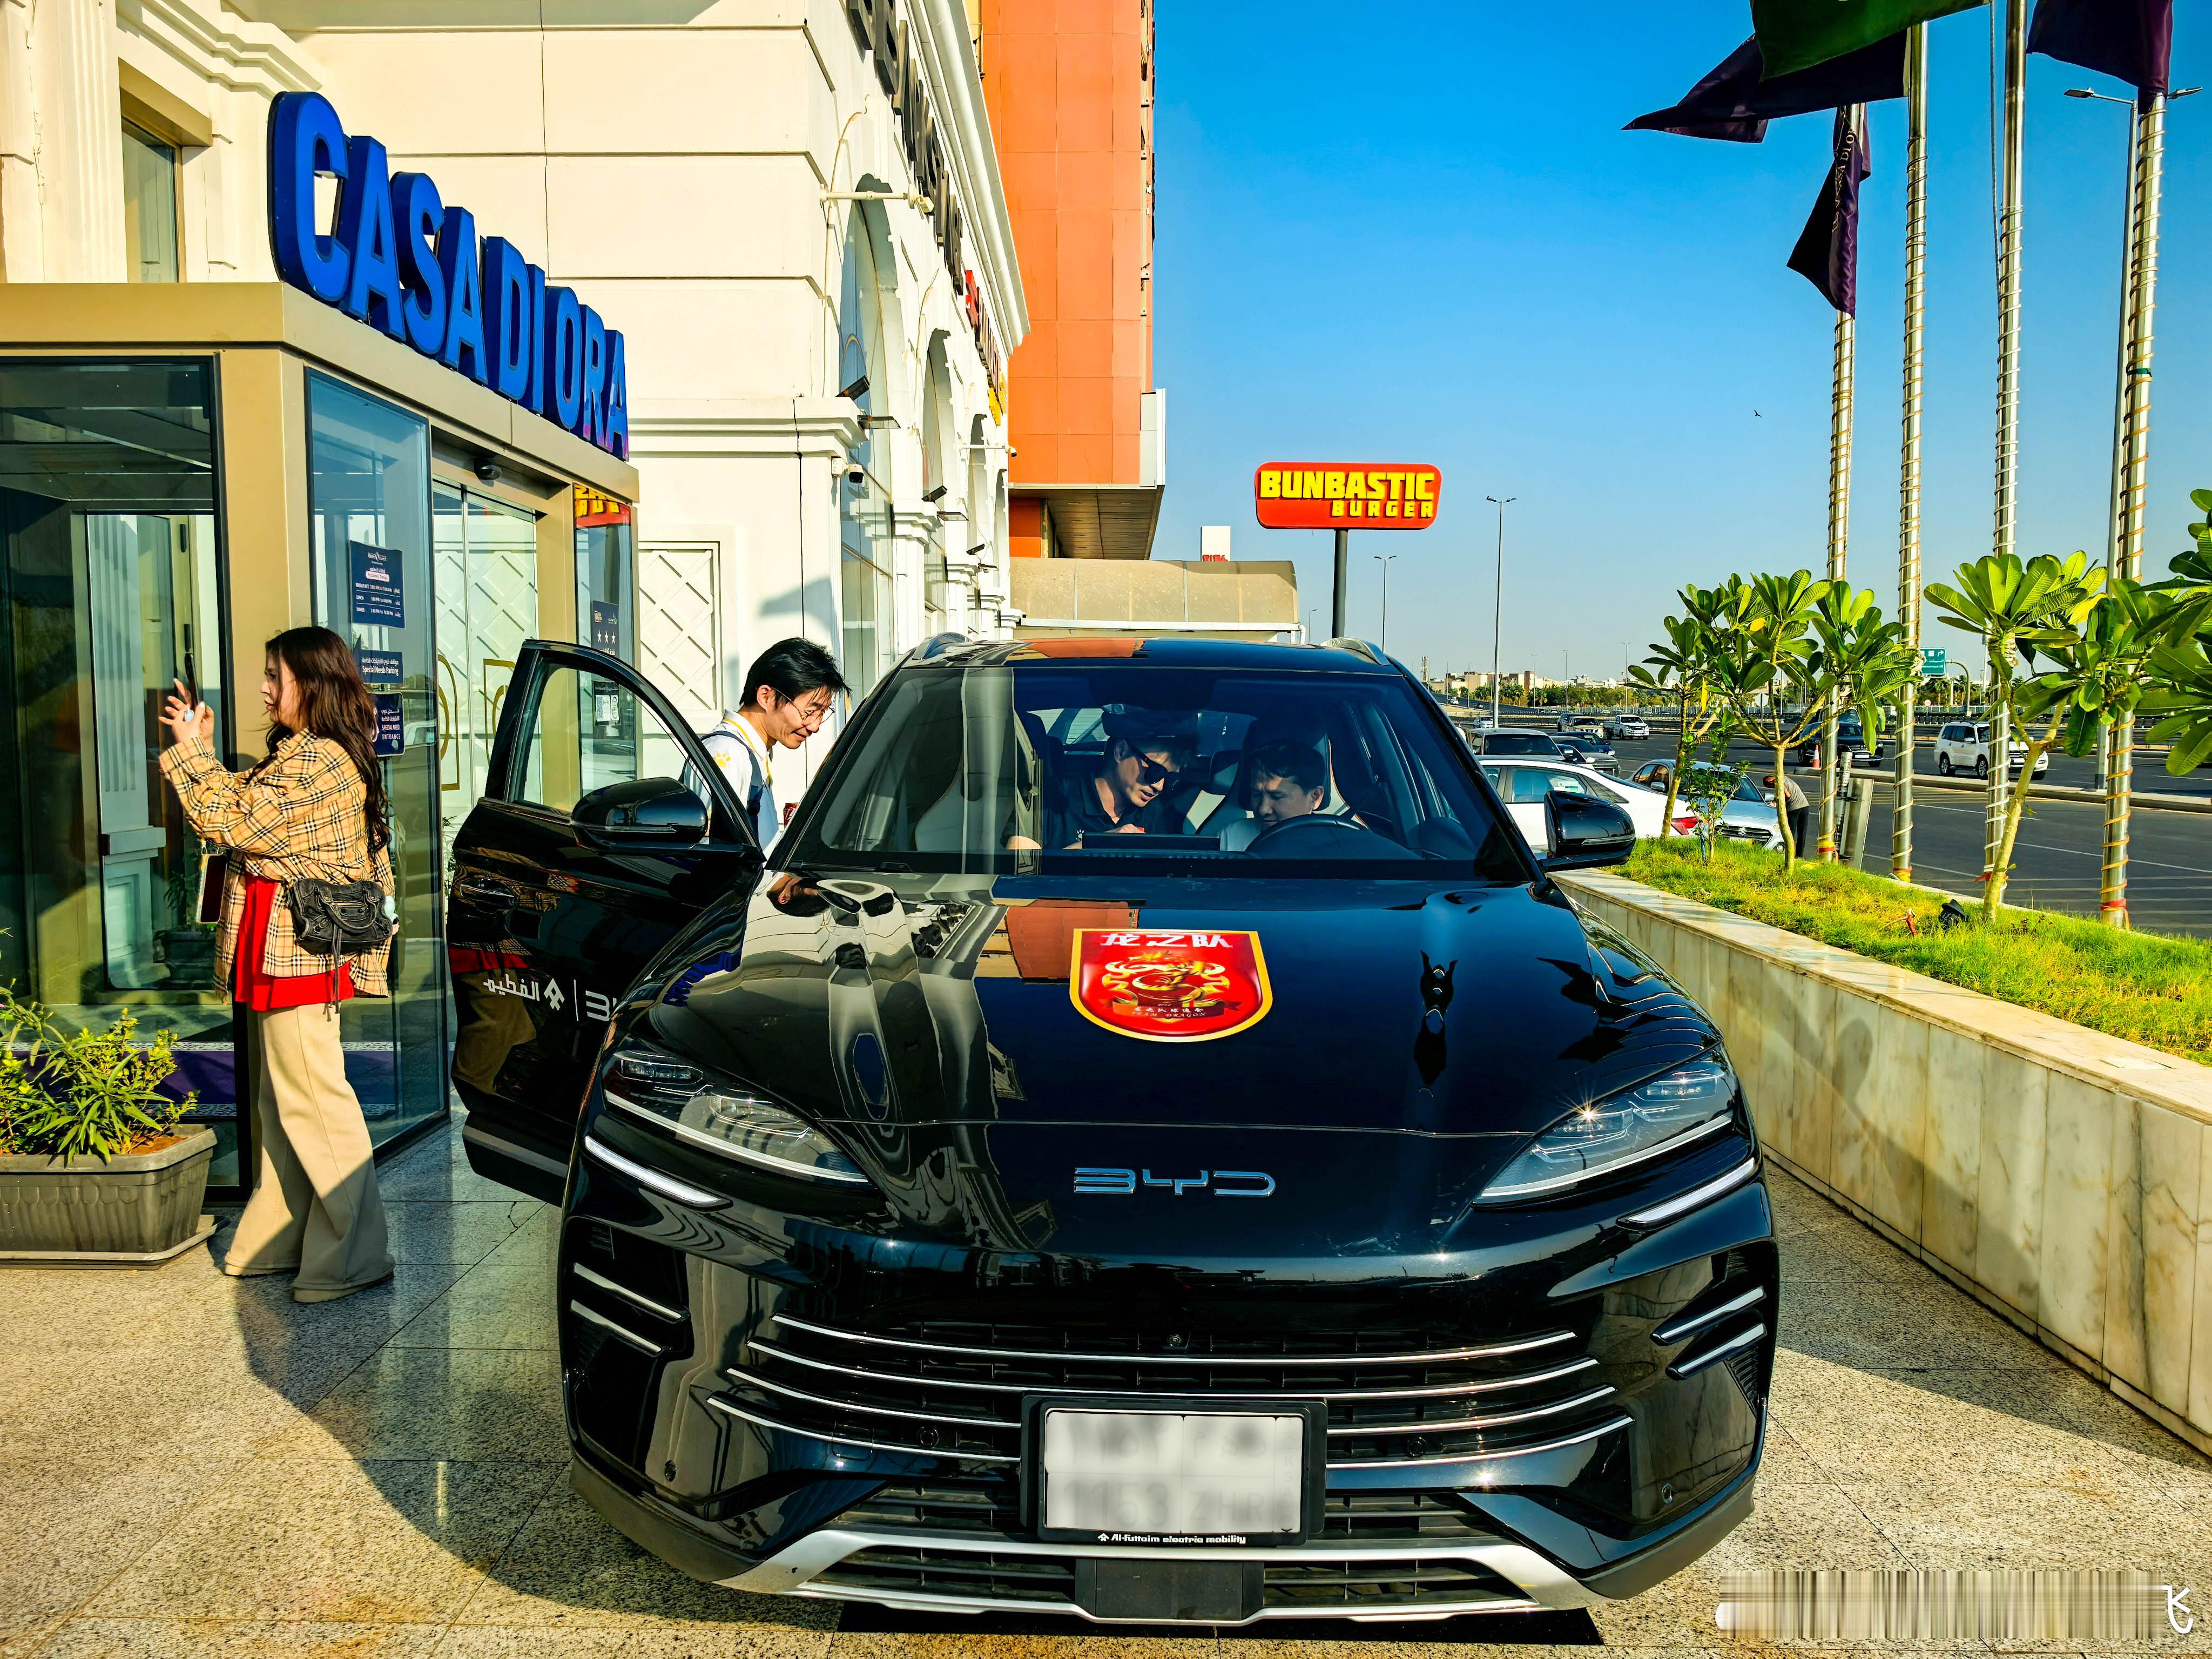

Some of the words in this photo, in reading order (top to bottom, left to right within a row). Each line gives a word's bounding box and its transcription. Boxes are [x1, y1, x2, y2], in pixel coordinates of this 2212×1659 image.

[267, 91, 488, 386] CASA
[1259, 470, 1435, 500] BUNBASTIC
[1331, 500, 1434, 518] BURGER
[362, 665, 375, 675] Special
[375, 666, 386, 675] Needs
[386, 666, 399, 677] Parking
[1100, 933, 1233, 948] 龙之队
[483, 974, 540, 1002] الفطيم
[1073, 1166, 1277, 1197] BYD
[1111, 1533, 1160, 1542] Al-Futtaim
[1206, 1535, 1246, 1545] mobility
